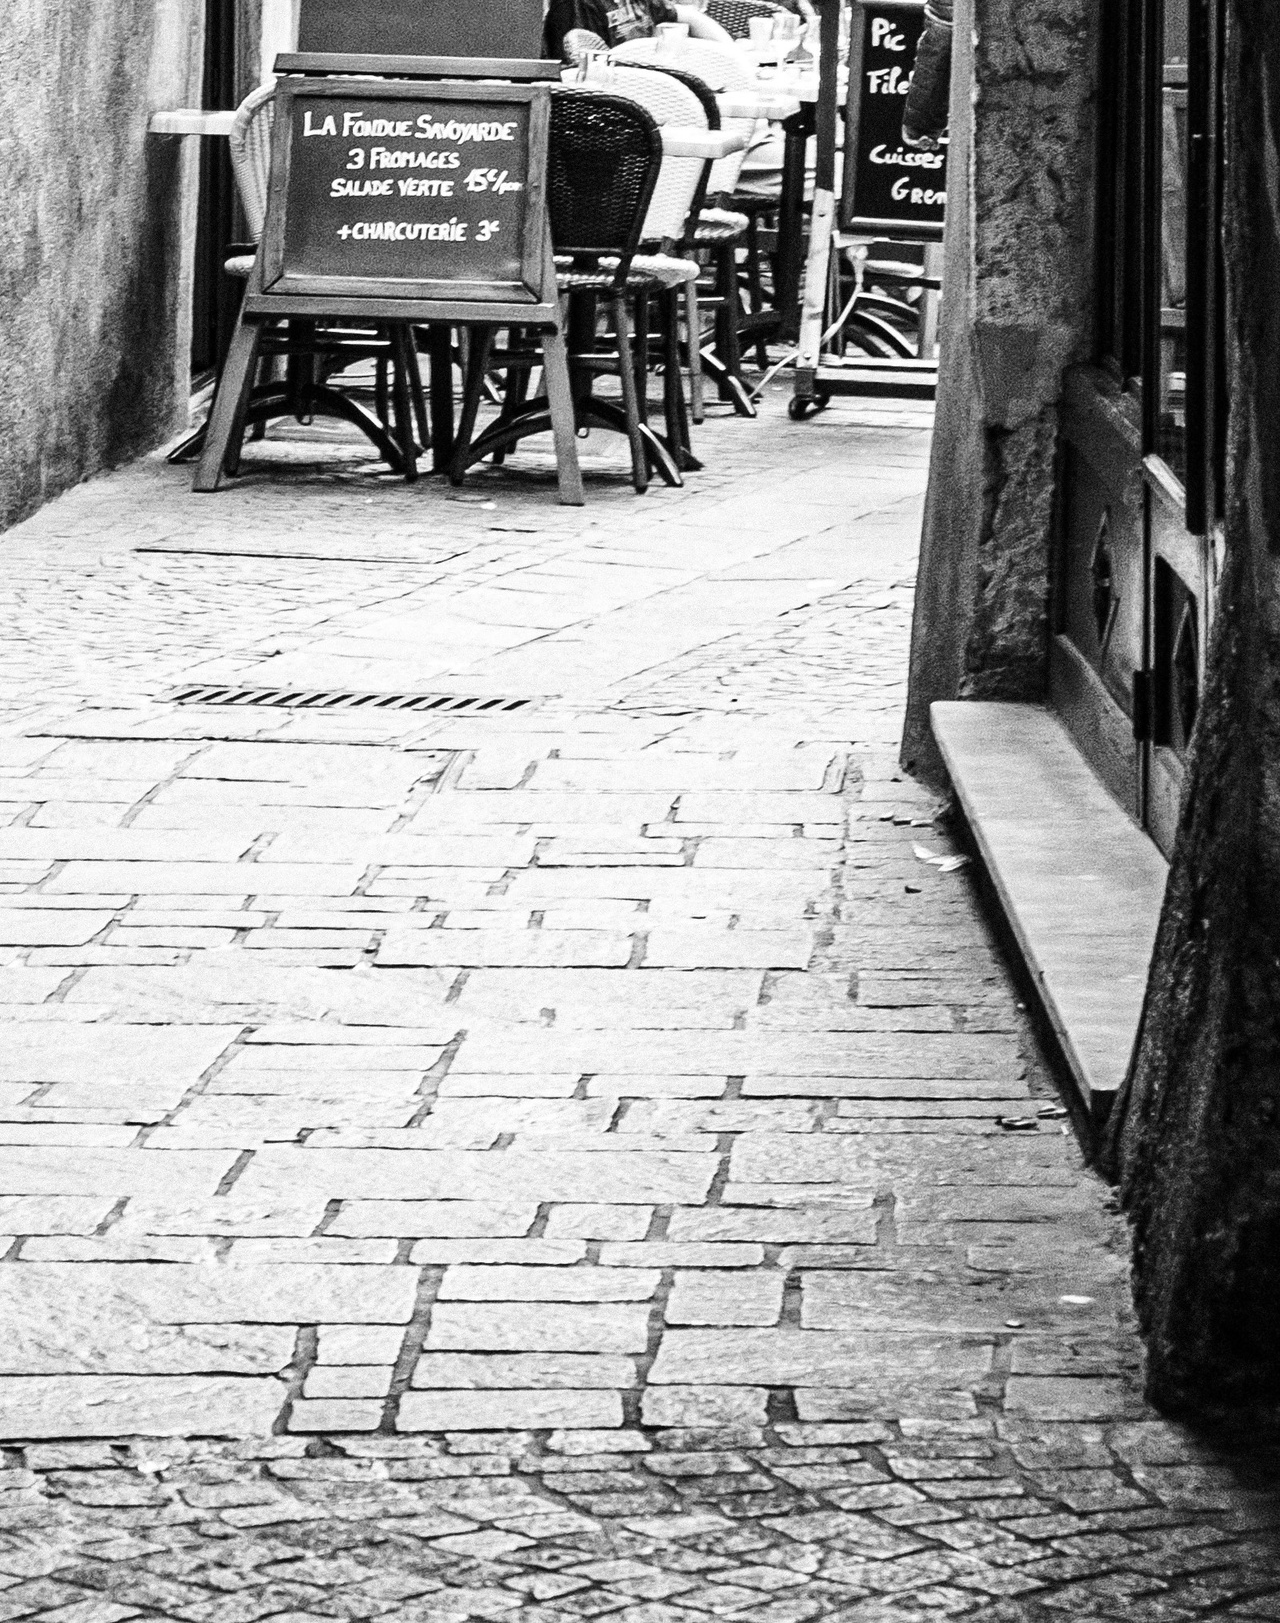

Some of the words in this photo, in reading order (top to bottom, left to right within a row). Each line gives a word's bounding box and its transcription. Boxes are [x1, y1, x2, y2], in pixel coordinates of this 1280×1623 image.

[871, 17, 907, 52] Pic
[303, 111, 337, 137] LA
[342, 111, 414, 137] FONDUE
[414, 114, 518, 145] SAVOYARDE
[346, 147, 366, 170] 3
[370, 147, 461, 170] FROMAGES
[870, 144, 945, 169] Cuisses
[330, 178, 394, 198] SALADE
[398, 178, 455, 197] VERTE
